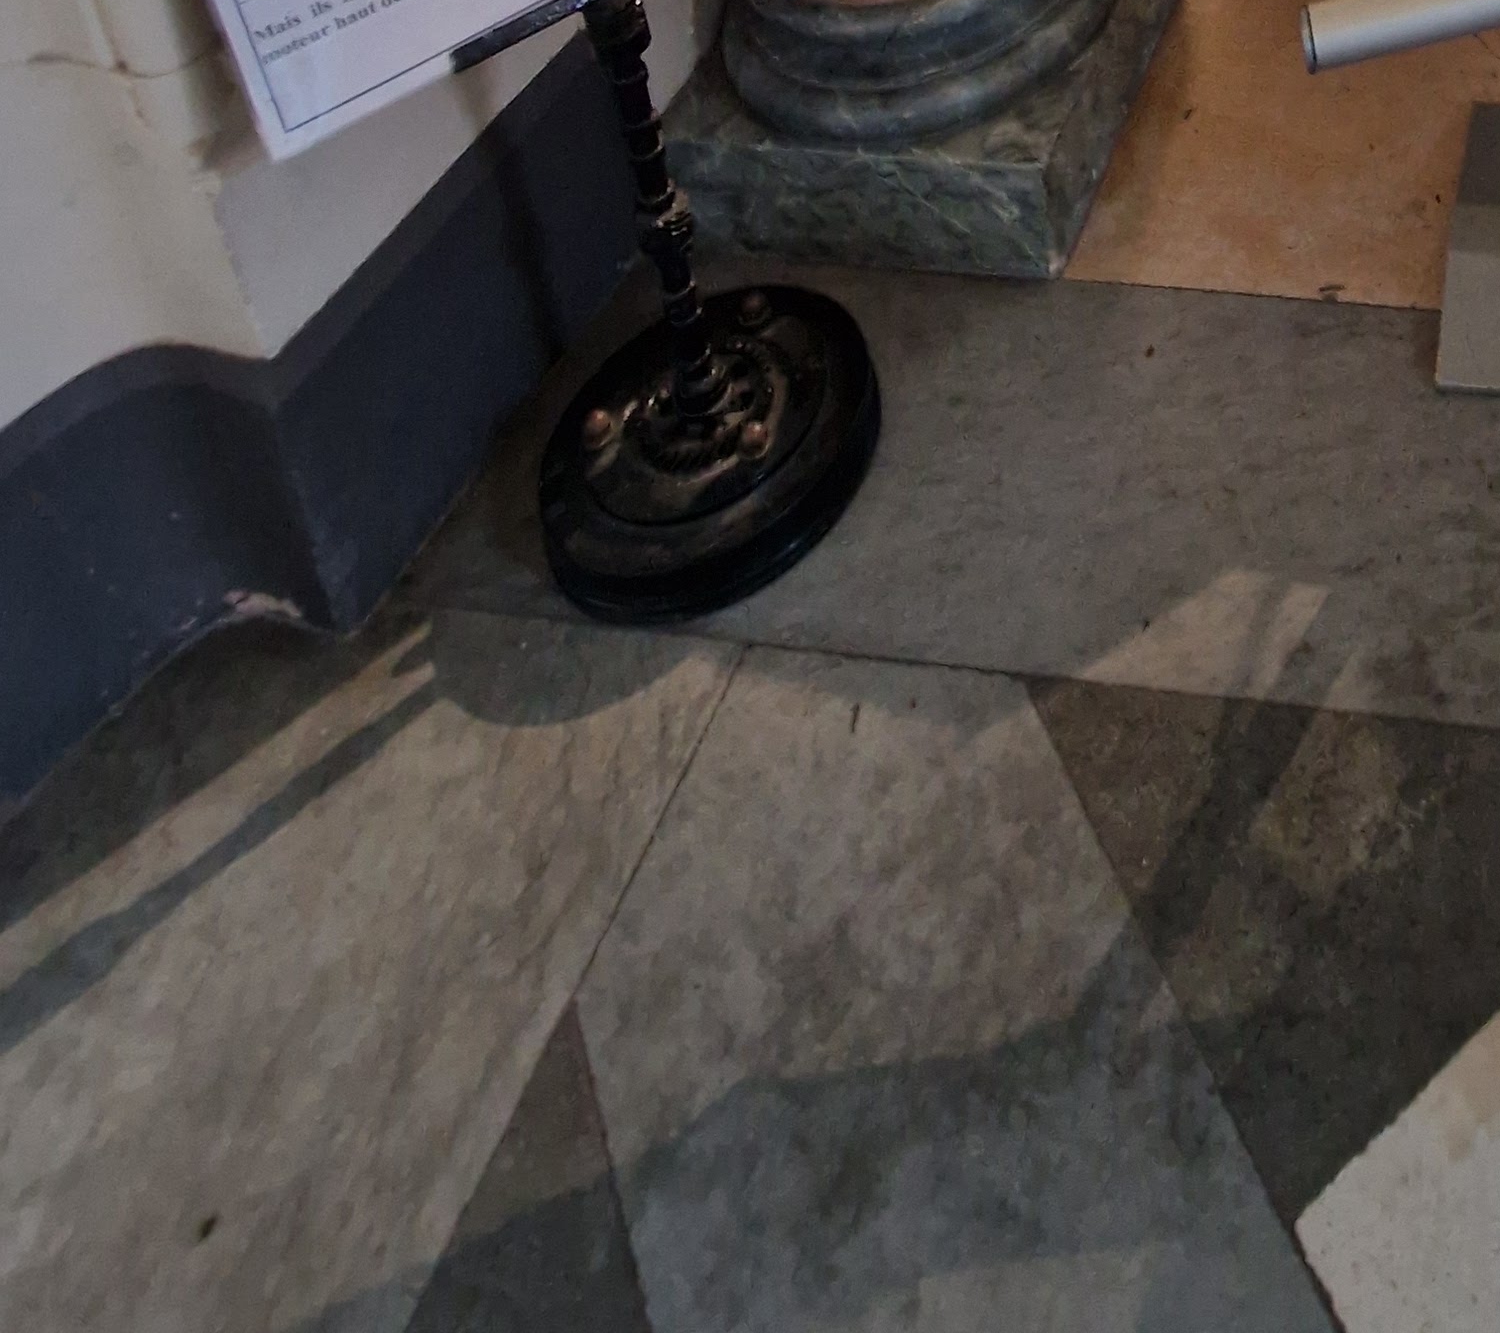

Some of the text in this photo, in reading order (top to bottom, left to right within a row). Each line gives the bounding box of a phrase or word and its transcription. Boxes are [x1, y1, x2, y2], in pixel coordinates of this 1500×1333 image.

[254, 16, 302, 44] Mais
[309, 1, 333, 18] ils
[262, 27, 332, 66] moteur
[333, 1, 377, 31] haut
